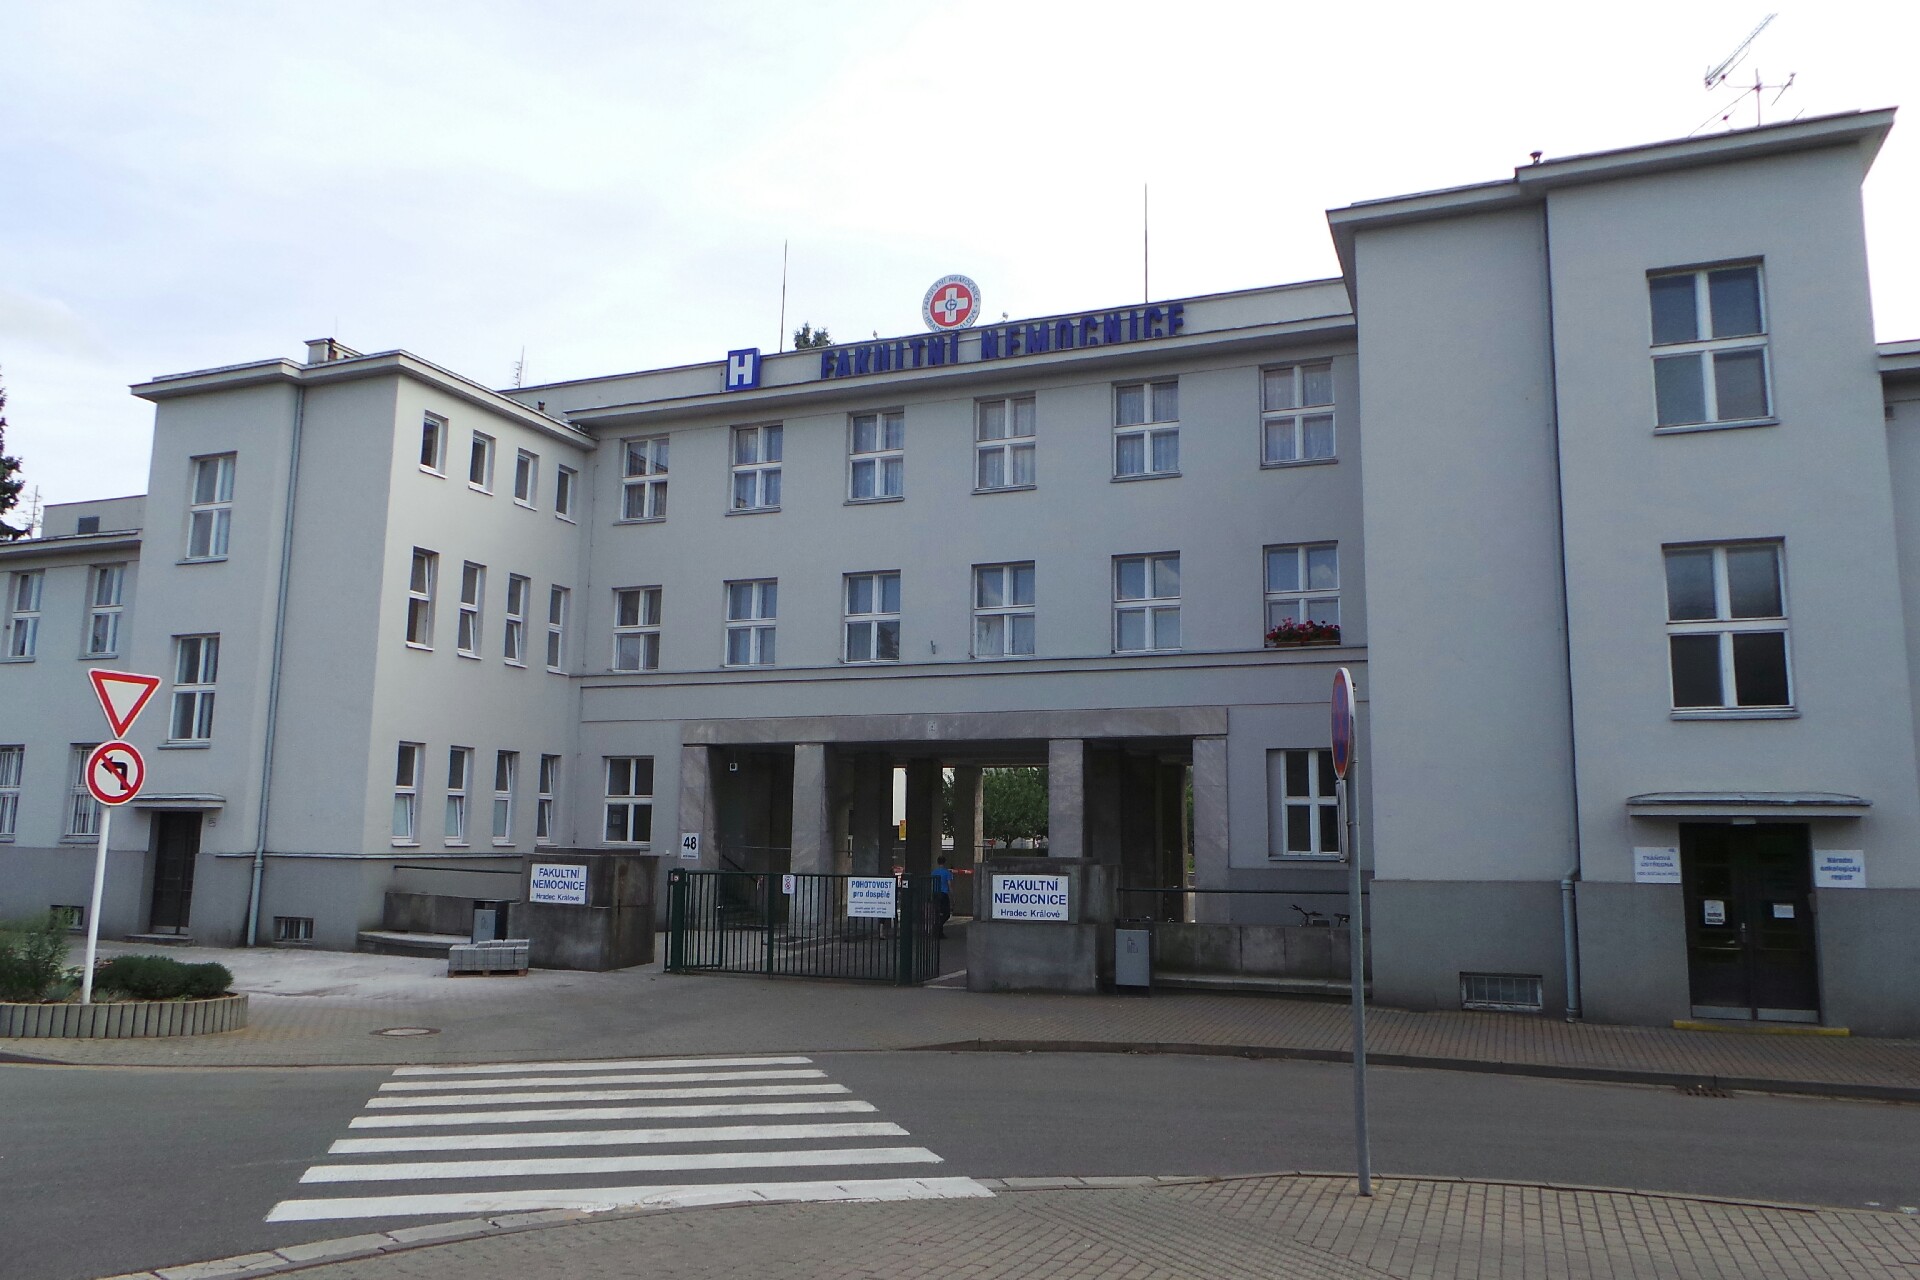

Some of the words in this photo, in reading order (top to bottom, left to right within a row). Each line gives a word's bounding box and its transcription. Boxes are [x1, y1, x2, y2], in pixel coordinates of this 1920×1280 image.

[981, 303, 1184, 360] NEMOCNICE
[729, 354, 754, 386] H
[683, 836, 697, 850] 48
[539, 867, 580, 879] FAKULTNÍ
[532, 879, 585, 891] NEMOCNICE
[851, 880, 893, 889] POHOTOVOST
[1002, 877, 1059, 891] FAKULTNÍ
[536, 893, 556, 901] Hradec
[865, 890, 891, 899] dospělé
[994, 892, 1067, 905] NEMOCNICE
[1000, 909, 1028, 917] Hradec
[1030, 909, 1060, 918] Králové
